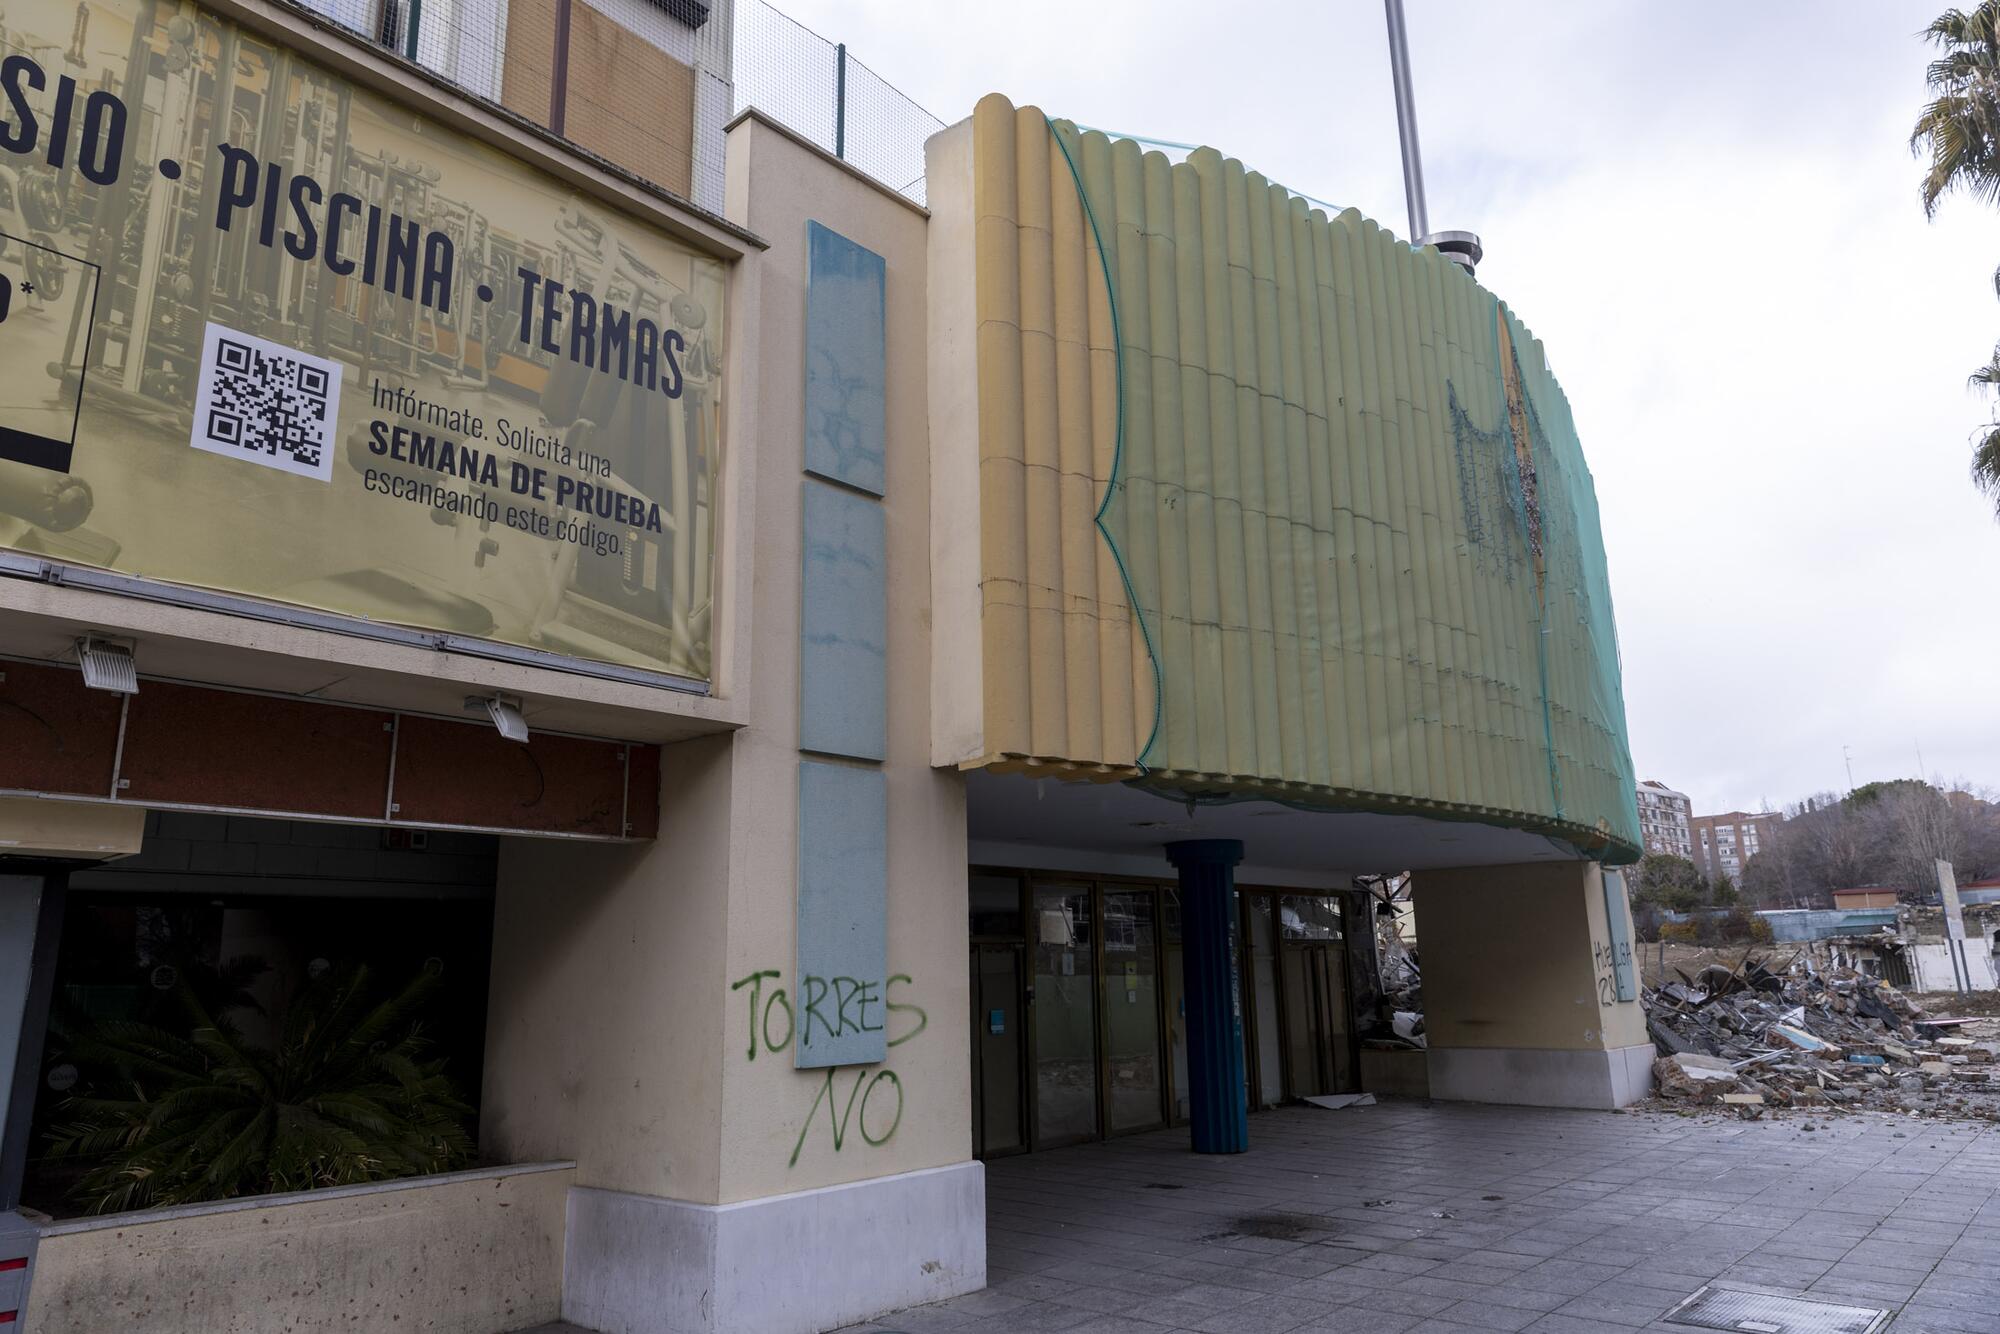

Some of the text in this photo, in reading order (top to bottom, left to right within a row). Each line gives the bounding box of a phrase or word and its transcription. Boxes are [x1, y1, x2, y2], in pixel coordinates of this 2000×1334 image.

[0, 55, 685, 400] SIO PISCINA TERMAS
[368, 419, 662, 534] SEMANA DE PRUEBA
[372, 377, 611, 480] Infórmate. Solicita una
[363, 468, 624, 557] escaneando este código.
[731, 970, 928, 1062] TORRES
[788, 1066, 904, 1169] NO
